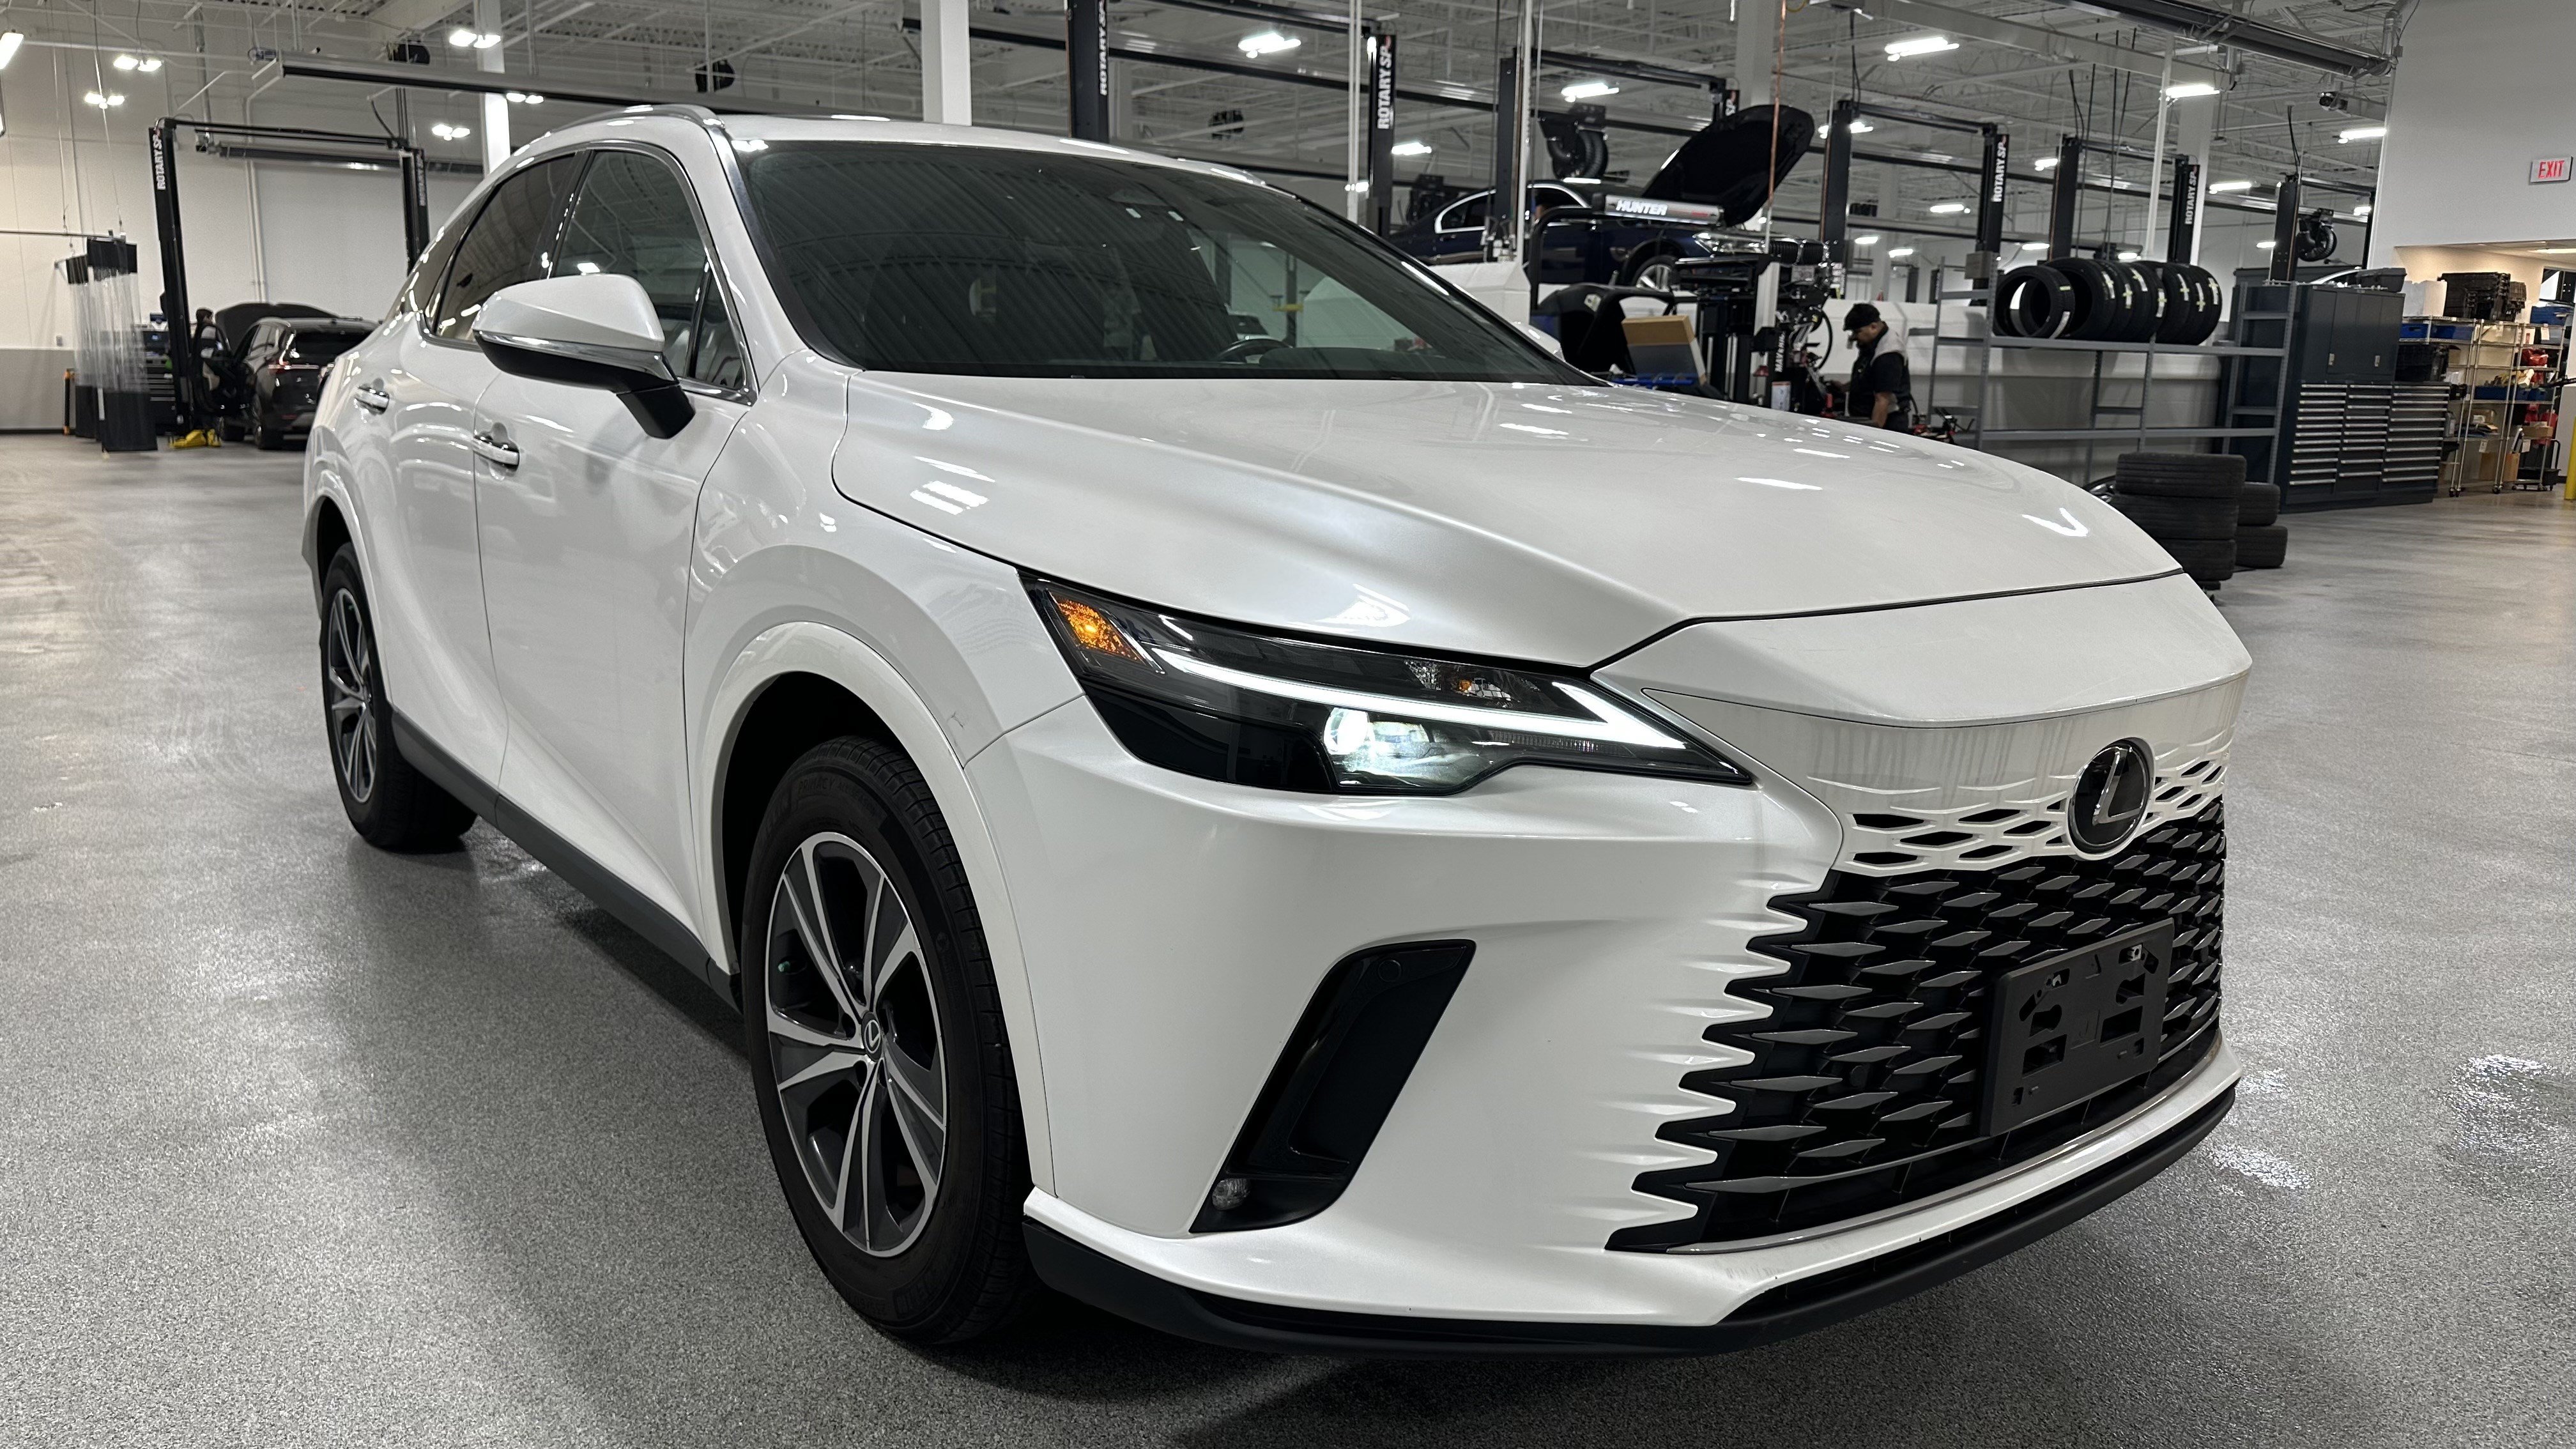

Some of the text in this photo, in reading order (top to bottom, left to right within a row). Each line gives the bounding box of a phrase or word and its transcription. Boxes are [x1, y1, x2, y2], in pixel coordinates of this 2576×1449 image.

[1099, 26, 1107, 96] ROTARY
[1377, 68, 1392, 129] ROTARY
[1993, 158, 2005, 202] ROTARY
[2538, 160, 2564, 178] EXIT
[1615, 199, 1667, 216] HUNTER
[2185, 185, 2196, 224] ROTARY
[798, 776, 835, 794] PRIMACY
